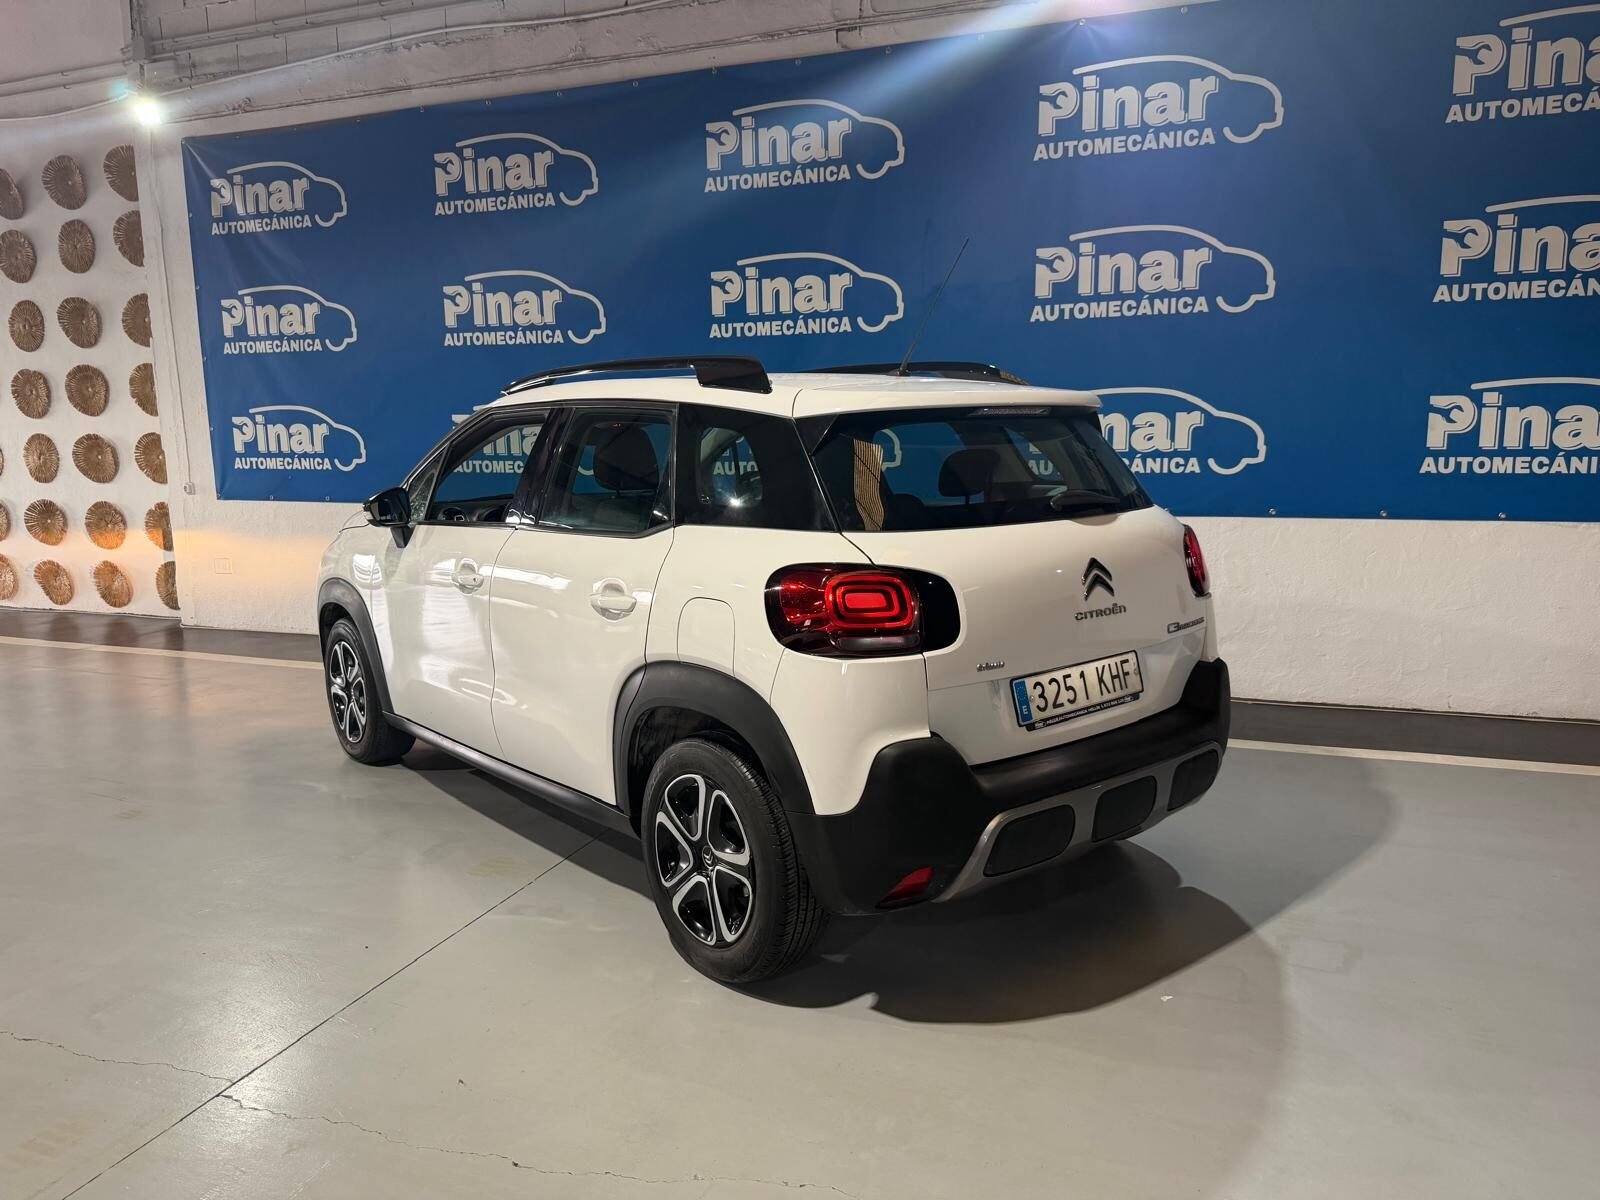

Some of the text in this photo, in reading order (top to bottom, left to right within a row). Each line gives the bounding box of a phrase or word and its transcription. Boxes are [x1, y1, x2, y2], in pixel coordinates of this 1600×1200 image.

[1037, 73, 1219, 137] Pinar
[705, 115, 852, 171] Pinar
[1033, 128, 1216, 161] AUTOMECÁNICA
[433, 147, 555, 197] Pinar
[704, 162, 851, 193] AUTOMECÁNICA
[210, 174, 310, 218] Pinar
[434, 192, 556, 216] AUTOMECÁNICA
[211, 214, 312, 236] AUTOMECÁNICA
[1035, 242, 1212, 299] Pinar
[442, 282, 563, 329] Pinar
[710, 266, 853, 318] Pinar
[1030, 295, 1209, 323] AUTOMECÁNICA
[220, 294, 320, 338] Pinar
[709, 314, 852, 339] AUTOMECÁNICA
[223, 337, 323, 355] AUTOMECÁNICA
[443, 327, 564, 347] AUTOMECÁNICA
[231, 415, 330, 455] Pinar
[1098, 410, 1204, 453] nar
[234, 453, 332, 471] AUTOMECÁNICA
[453, 460, 524, 473] AUTOMEC
[1032, 670, 1090, 713] 3251
[1096, 658, 1131, 697] KHF
[1022, 705, 1029, 715] E
